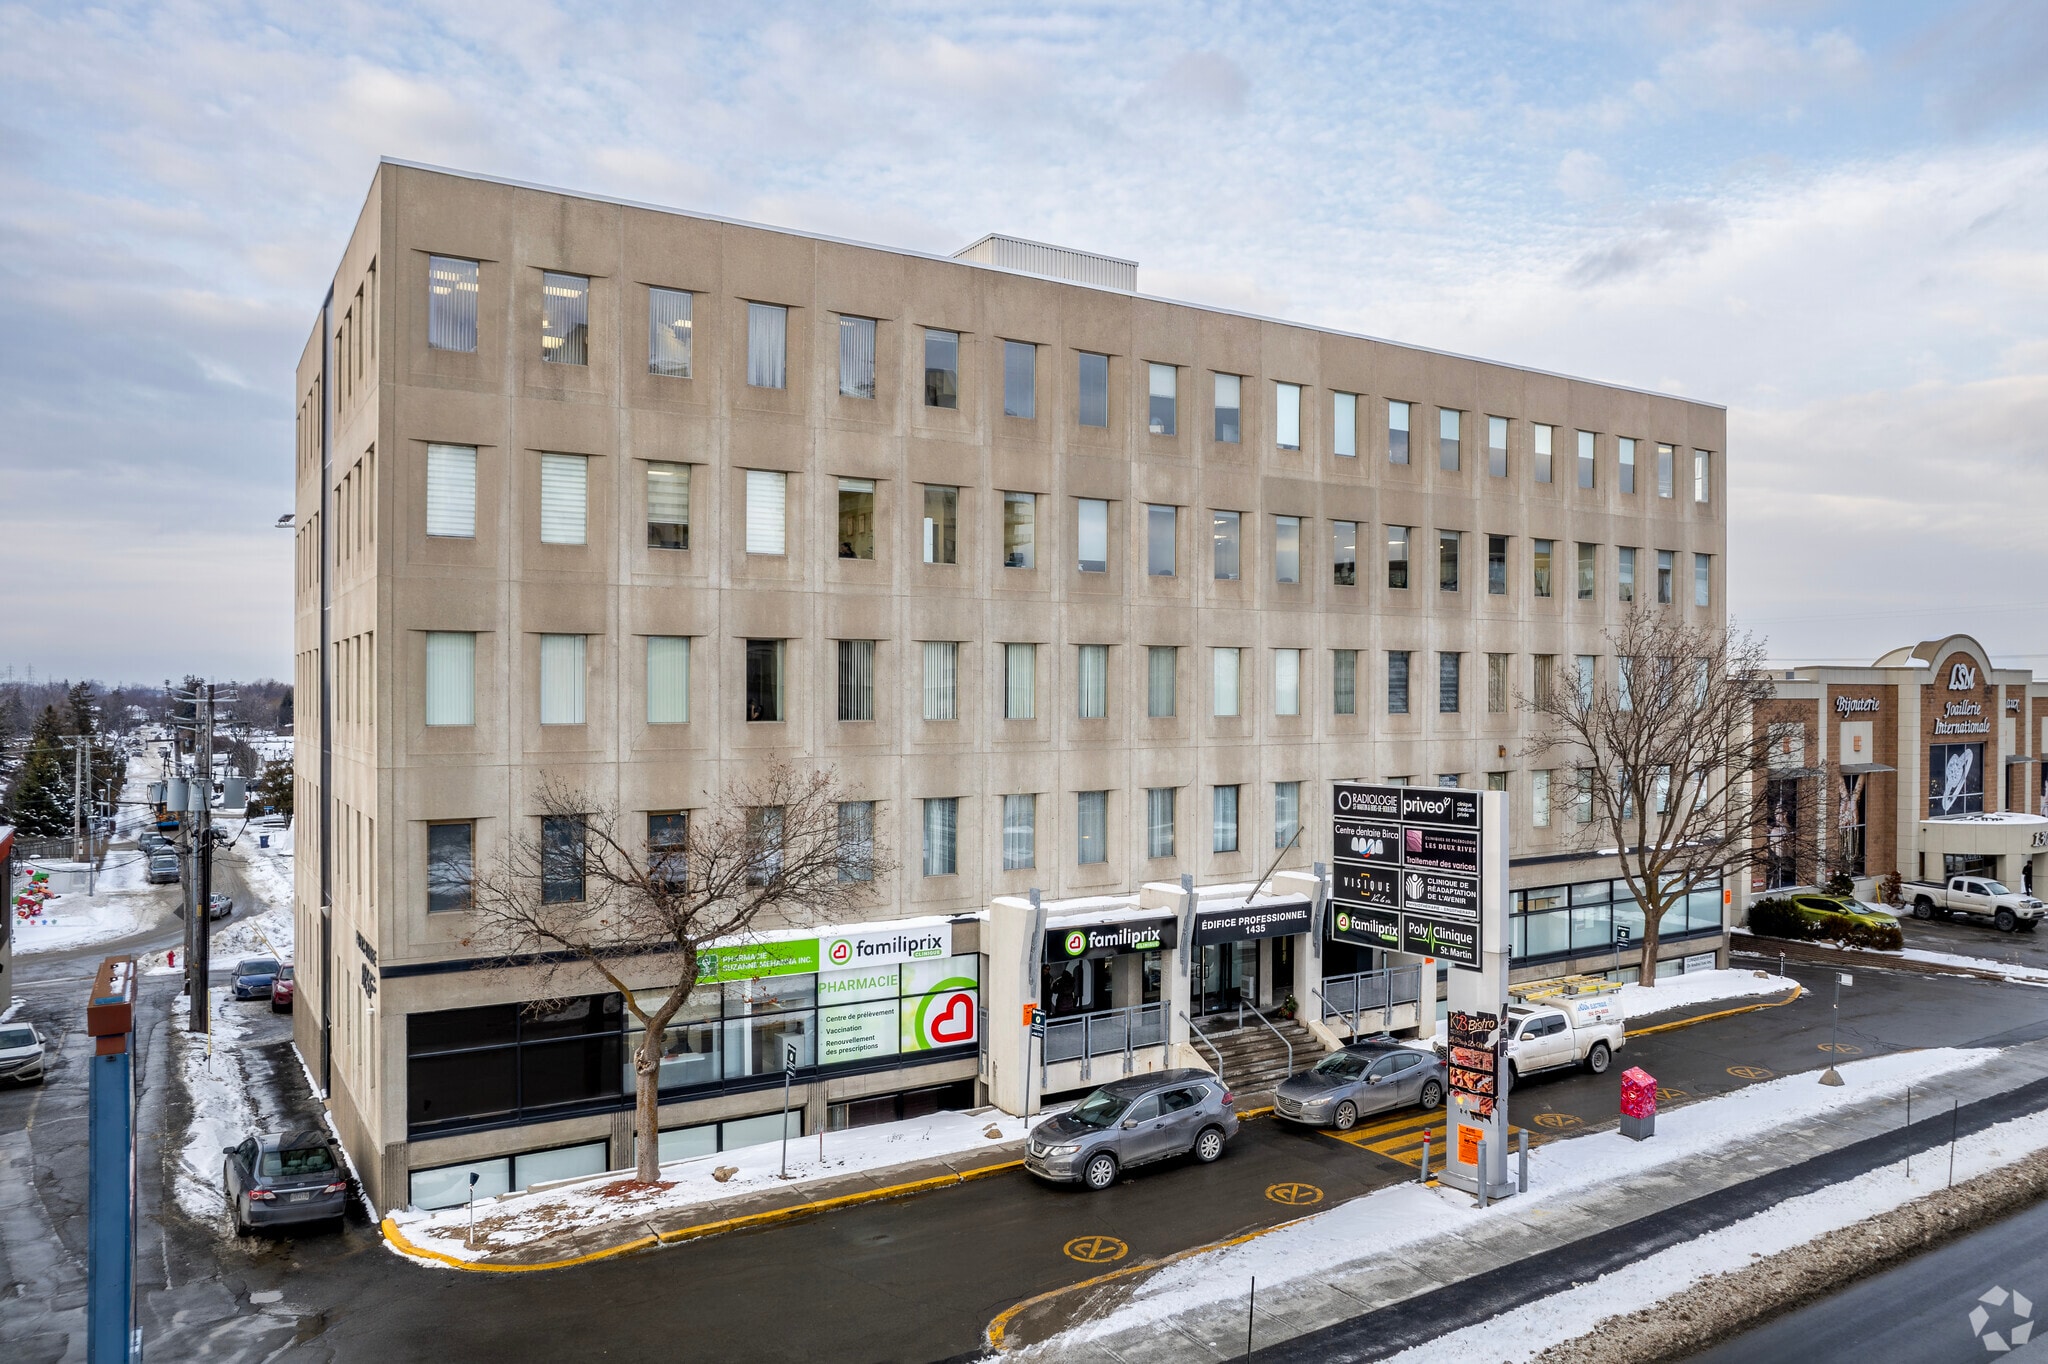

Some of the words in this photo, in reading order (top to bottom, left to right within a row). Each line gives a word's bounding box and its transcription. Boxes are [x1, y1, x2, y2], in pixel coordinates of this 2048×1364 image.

[1948, 663, 1976, 691] LSM
[1836, 695, 1880, 718] Bijouterie
[1943, 699, 1981, 719] Joaillerie
[1934, 717, 1990, 735] Internationale
[1352, 793, 1398, 807] RADIOLOGIE
[1403, 796, 1444, 815] priveo
[1335, 824, 1355, 835] Centre
[1356, 825, 1381, 838] dentaire
[1457, 845, 1476, 854] RIVES
[1406, 856, 1439, 867] Traitement
[1440, 860, 1452, 868] des
[1452, 862, 1476, 871] varices
[1344, 876, 1390, 893] VISIQUE
[1427, 878, 1458, 888] CLINIQUE
[1427, 885, 1477, 898] RÉADAPTATION
[1438, 894, 1467, 904] L'AVENIR
[1201, 918, 1237, 930] ÉDIFICE
[1238, 910, 1308, 926] PROFESSIONNEL
[1351, 916, 1398, 938] familiprix
[1245, 924, 1266, 934] 1435
[1408, 922, 1428, 938] Poly
[1433, 926, 1473, 944] Clinique
[1088, 926, 1160, 949] familiprix
[856, 933, 942, 957] familiprix
[798, 956, 813, 964] INC.
[914, 950, 941, 958] CLINIQUE
[1440, 946, 1449, 955] St.
[1449, 948, 1472, 960] Martin
[818, 974, 898, 994] PHARMACIE
[825, 1014, 847, 1023] Centre
[856, 1008, 895, 1020] prélèvement
[825, 1024, 863, 1035] Vaccination
[1468, 1018, 1495, 1031] Bistro
[825, 1035, 876, 1047] Renouvellement
[825, 1047, 838, 1056] des
[838, 1042, 879, 1055] prescriptions
